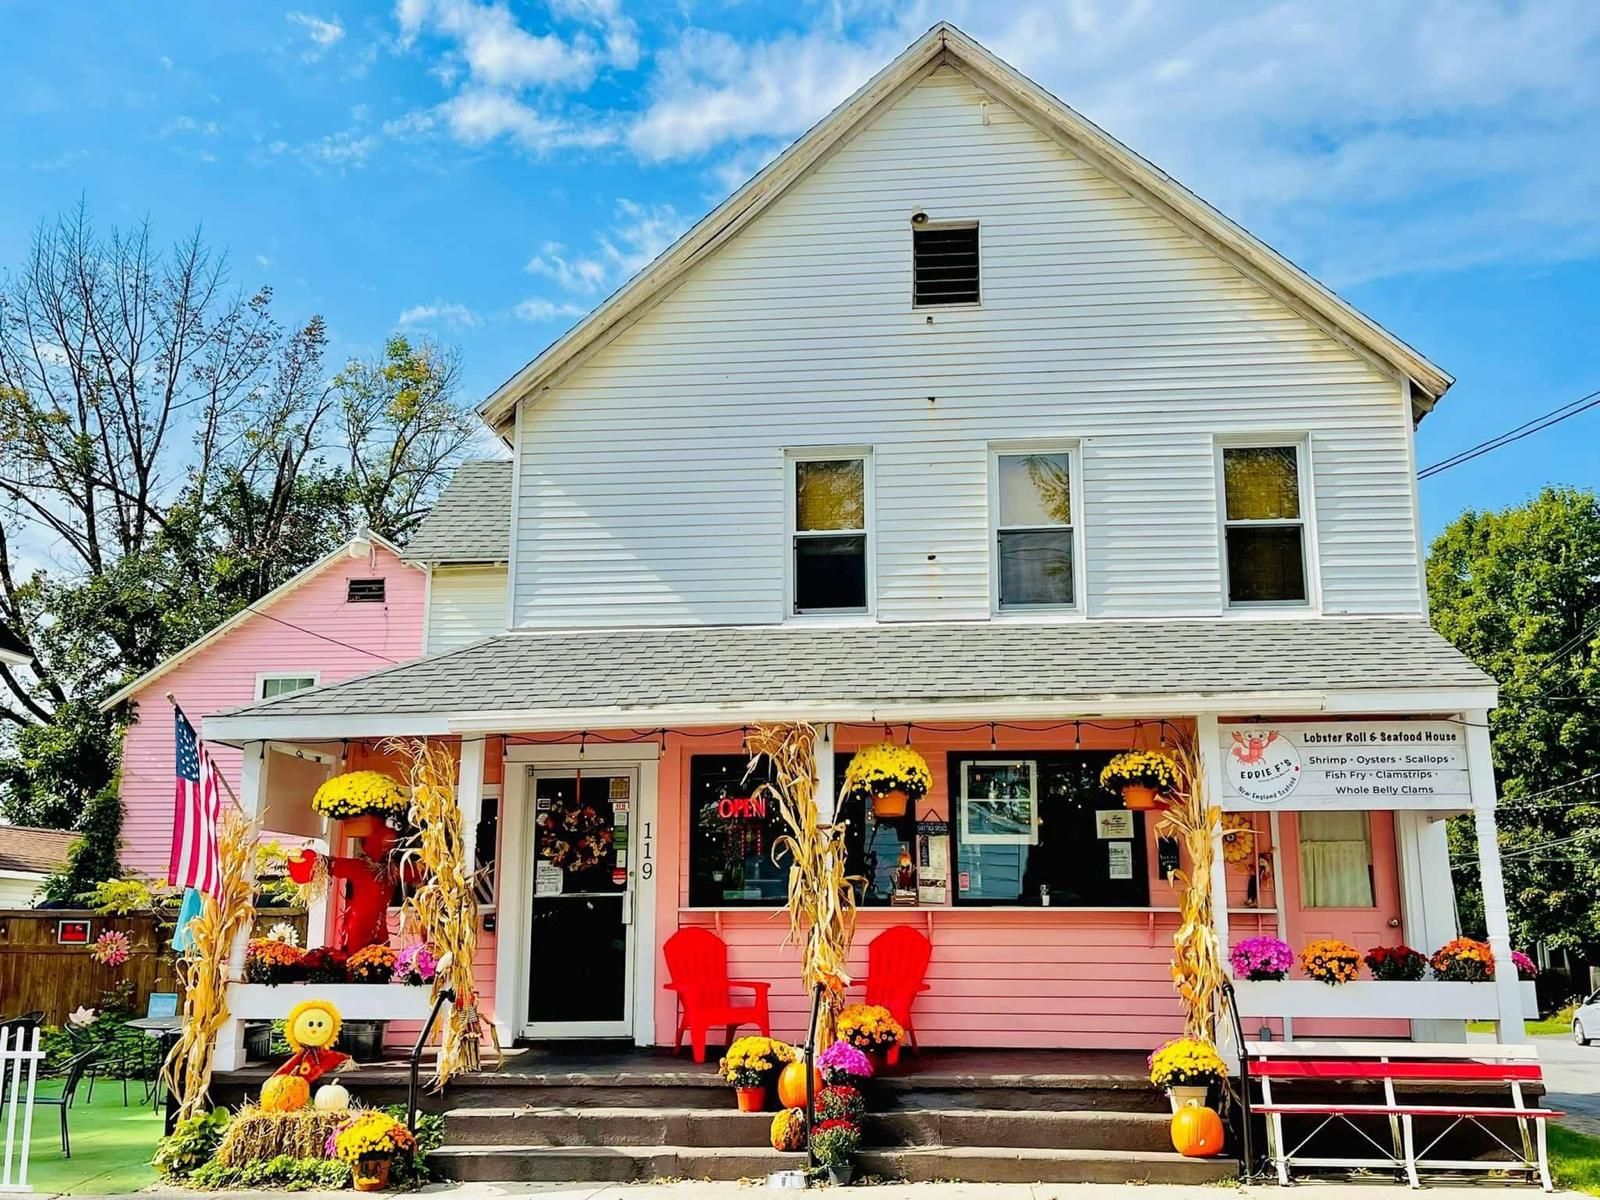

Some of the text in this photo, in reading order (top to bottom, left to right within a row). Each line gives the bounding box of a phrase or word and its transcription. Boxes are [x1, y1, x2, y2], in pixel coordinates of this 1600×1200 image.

[1303, 731, 1457, 744] Lobster Roll & Seafood House
[1309, 755, 1449, 766] Shrimp Oysters Scallops
[1240, 767, 1272, 780] EDDIE
[1274, 758, 1292, 773] F'S
[1325, 770, 1433, 781] Fish Fry Clamstrips
[1237, 785, 1251, 797] New
[1252, 792, 1278, 801] England
[1335, 785, 1434, 796] Whole Belly Clams
[718, 797, 767, 818] OPEN
[641, 821, 654, 881] 119
